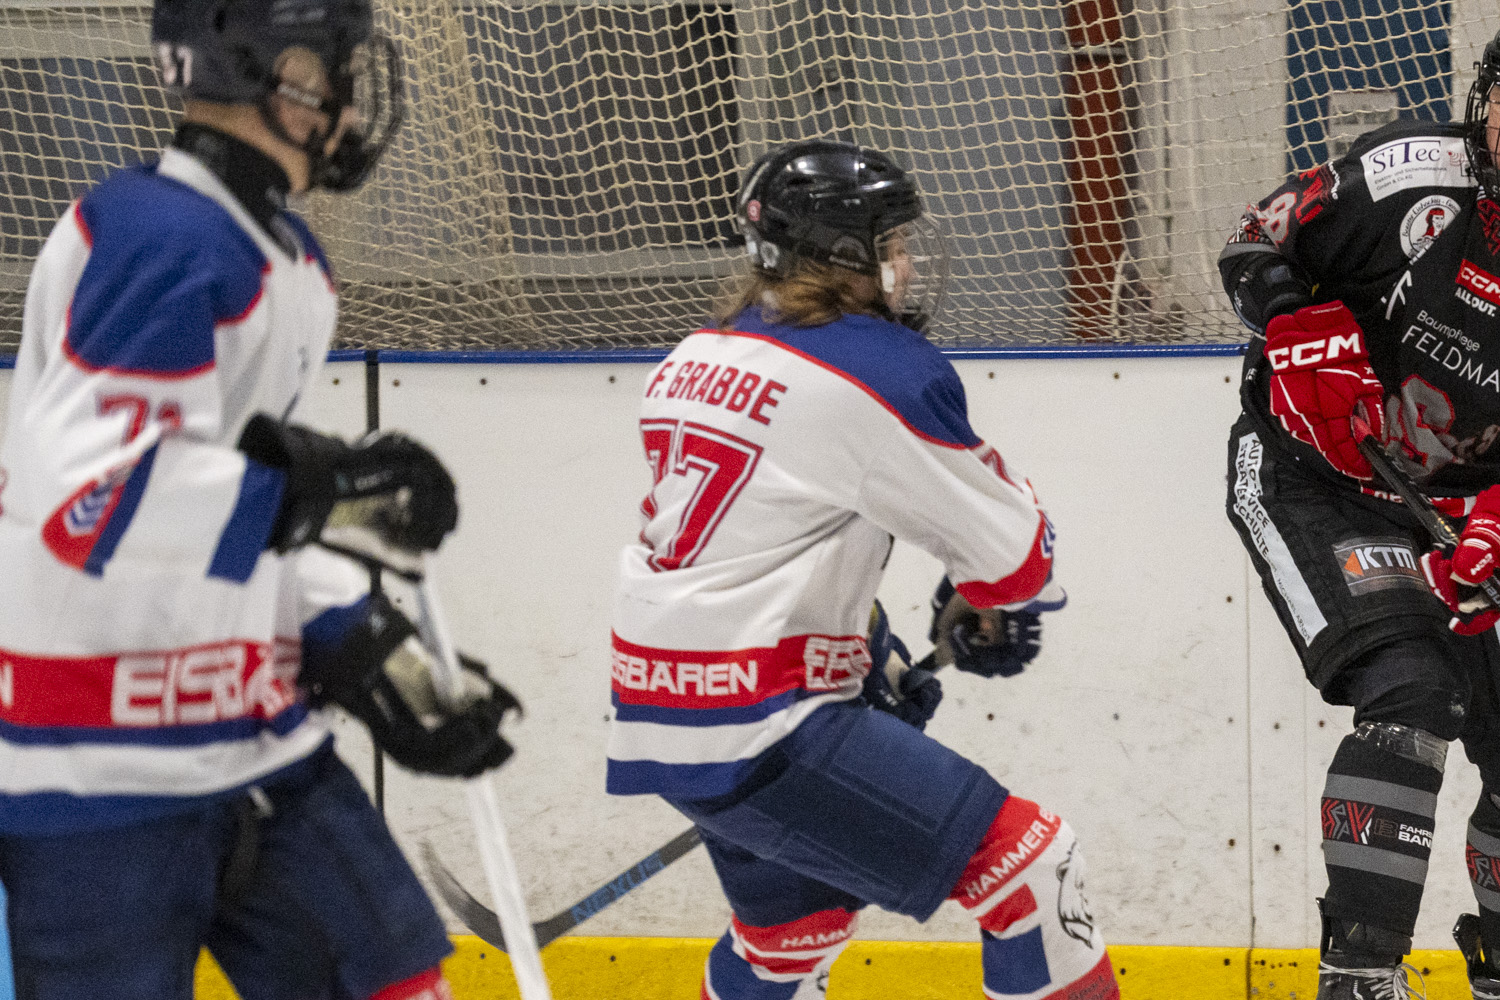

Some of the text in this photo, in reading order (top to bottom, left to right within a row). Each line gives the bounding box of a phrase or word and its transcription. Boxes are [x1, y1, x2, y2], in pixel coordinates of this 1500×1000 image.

[1371, 141, 1441, 175] SiTec
[1268, 332, 1362, 370] CCM
[1416, 309, 1481, 352] Baumpflege
[666, 361, 788, 426] GRABBE
[639, 417, 765, 574] 77
[1354, 546, 1418, 571] KTM
[965, 817, 1050, 900] HAMMER
